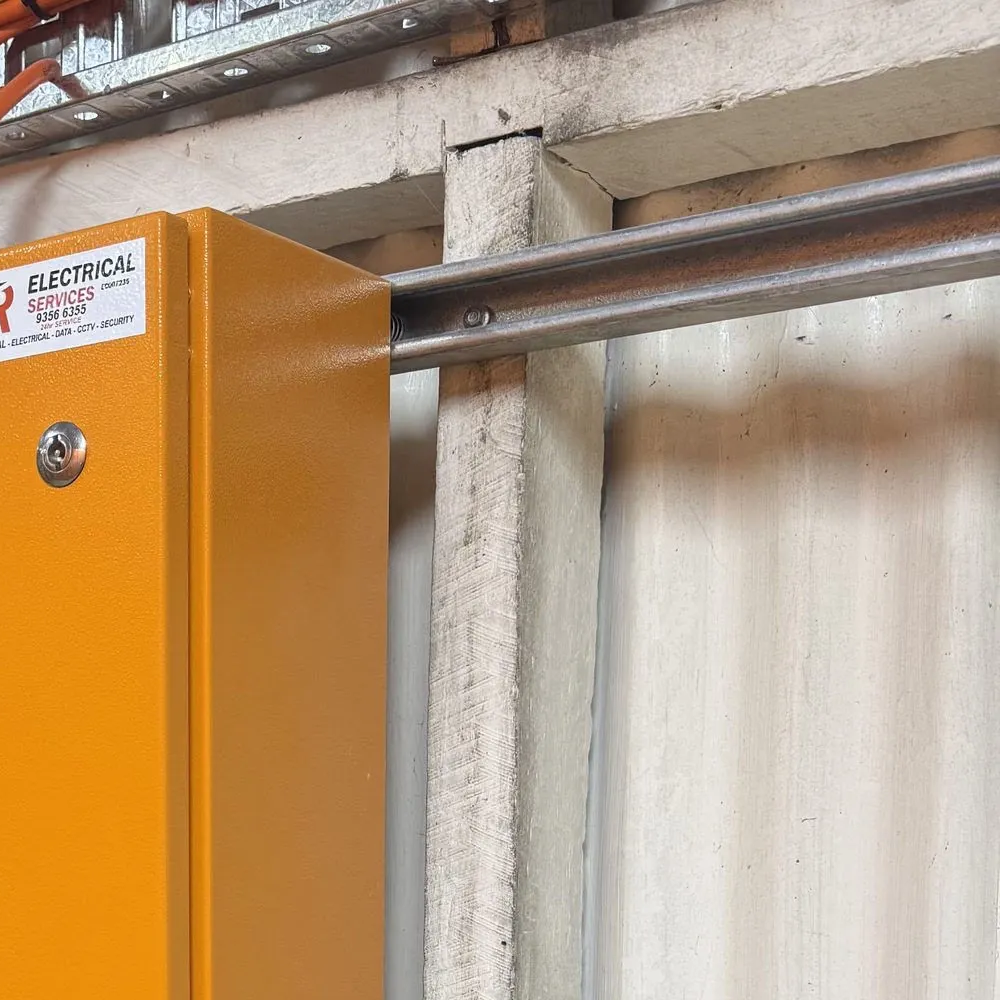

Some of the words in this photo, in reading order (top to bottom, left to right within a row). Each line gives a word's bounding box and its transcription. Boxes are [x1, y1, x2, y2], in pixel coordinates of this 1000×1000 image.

[28, 253, 136, 294] ELECTRICAL
[27, 285, 95, 313] SERVICES
[36, 309, 60, 324] 9356
[62, 303, 87, 318] 6355
[55, 316, 82, 328] SERVICE
[11, 332, 50, 346] ELECTRICAL
[55, 328, 72, 338] DATA
[77, 322, 96, 333] CCTV
[100, 315, 135, 329] SECURITY
